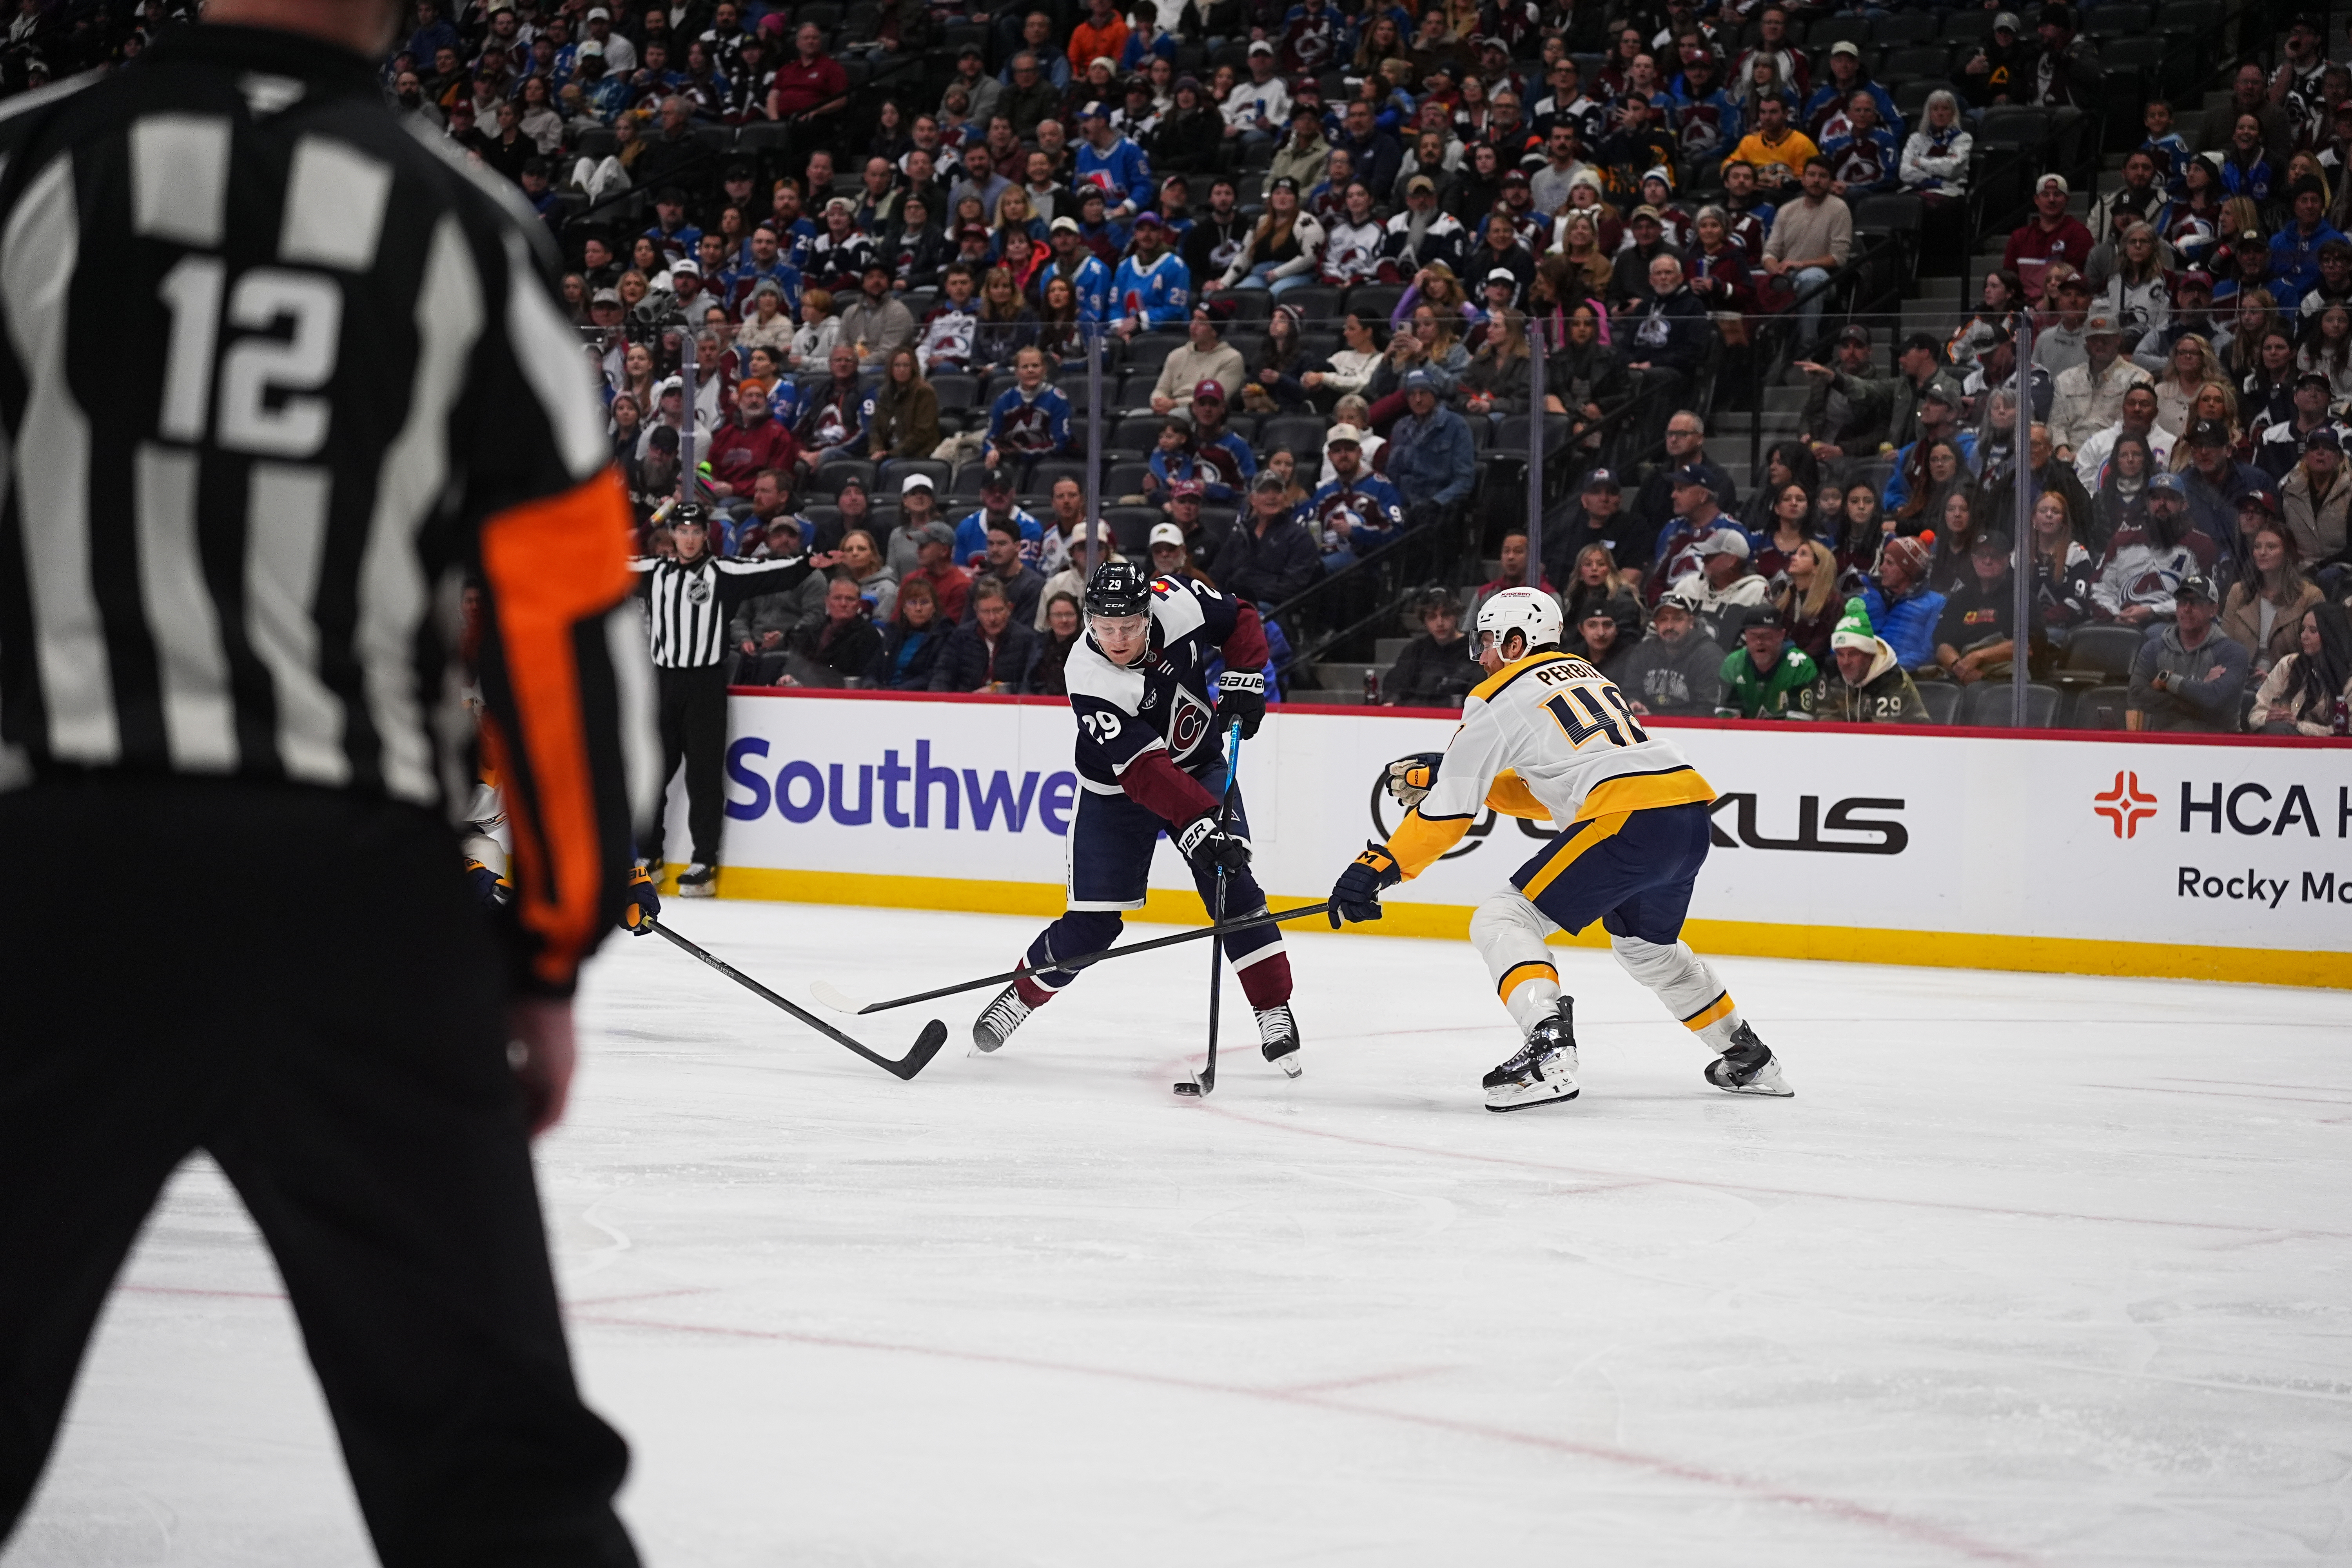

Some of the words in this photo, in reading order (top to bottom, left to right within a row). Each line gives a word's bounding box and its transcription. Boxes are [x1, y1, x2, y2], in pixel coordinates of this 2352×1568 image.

[159, 256, 343, 456] 12
[1108, 579, 1122, 590] 29
[1191, 579, 1223, 600] 2
[2074, 579, 2087, 598] 9
[1189, 639, 1198, 669] A
[1535, 664, 1604, 686] PERBIX
[1537, 682, 1651, 751] 48
[1877, 696, 1902, 718] 29
[1081, 710, 1122, 745] 29
[724, 736, 1076, 836] Southwe
[2180, 781, 2320, 838] HCA
[1181, 822, 1207, 853] UER
[2178, 867, 2289, 909] Rocky
[2301, 871, 2352, 904] Mo
[706, 958, 735, 978] BAUER
